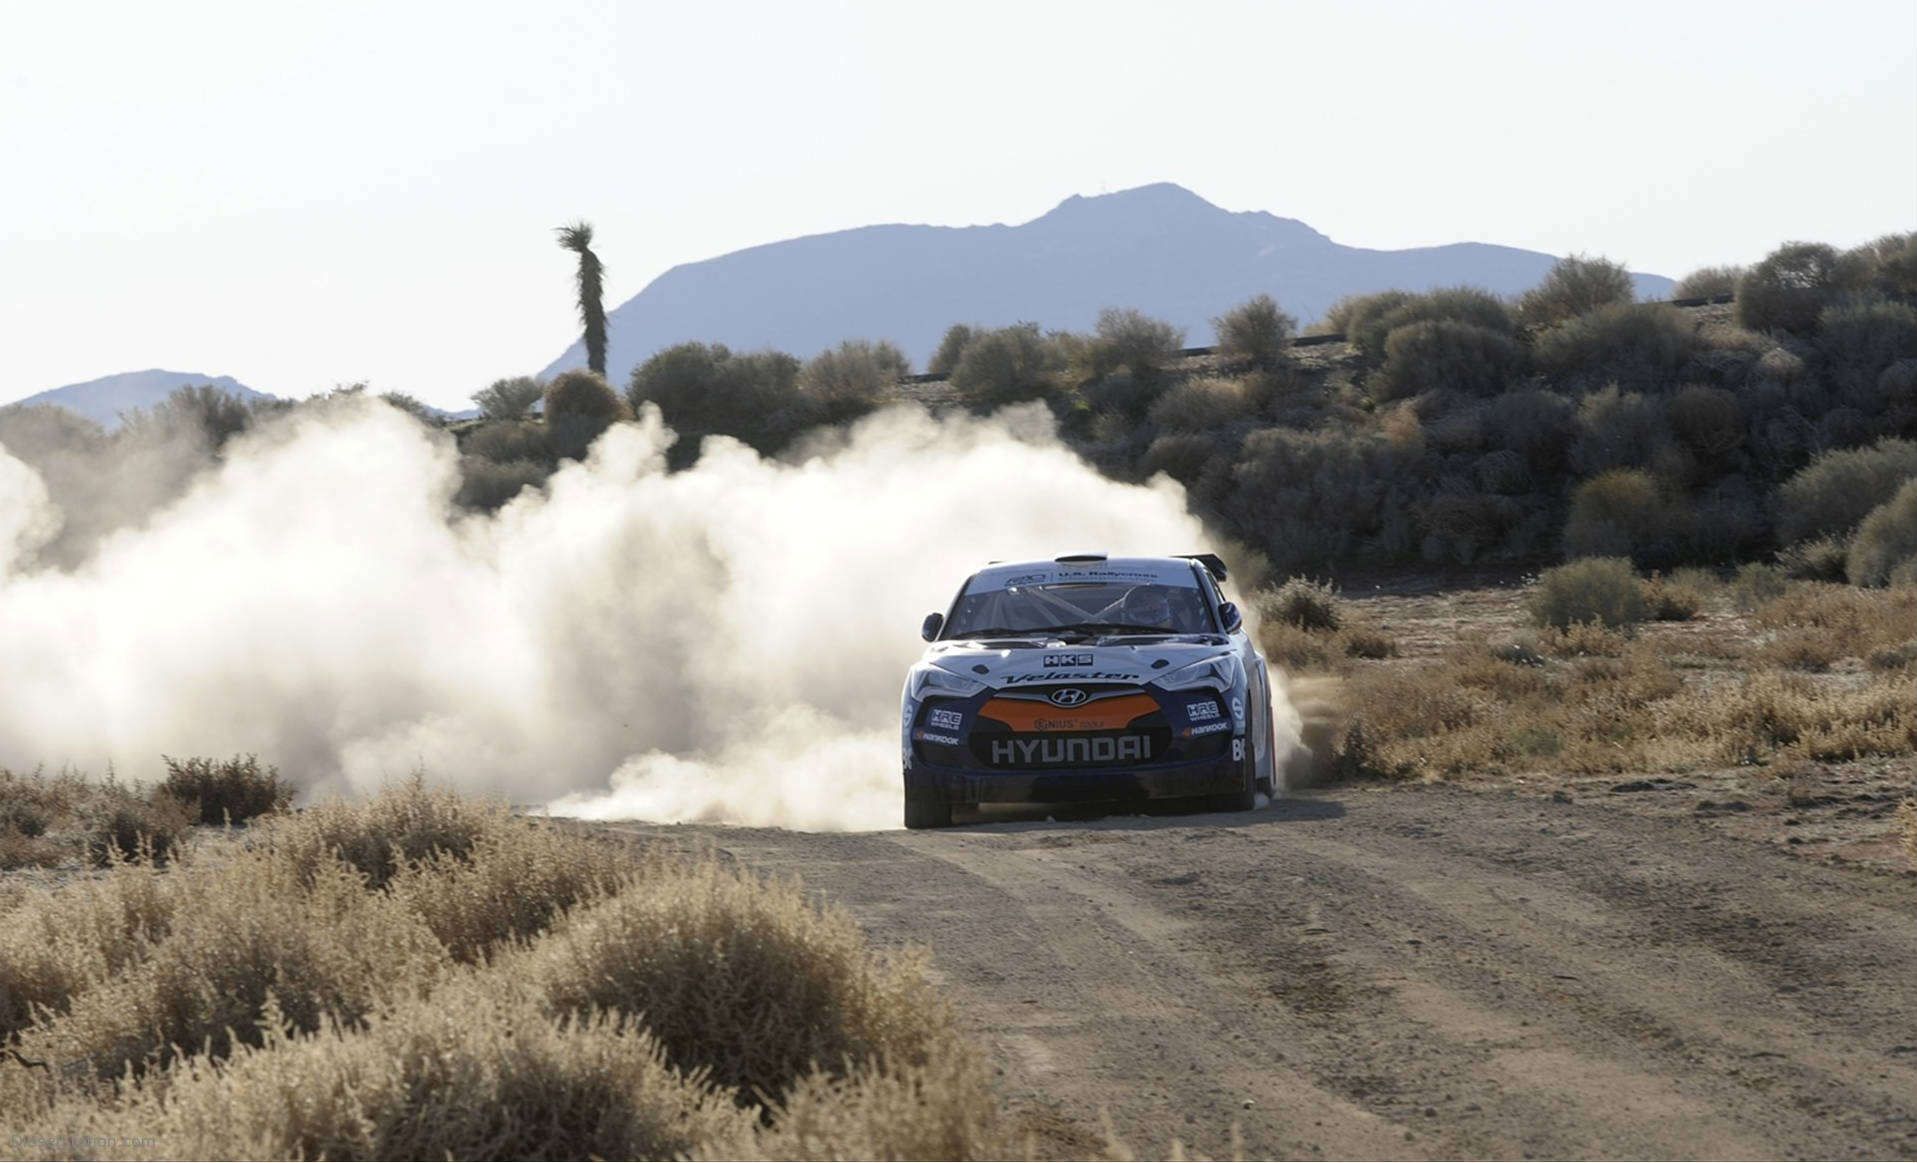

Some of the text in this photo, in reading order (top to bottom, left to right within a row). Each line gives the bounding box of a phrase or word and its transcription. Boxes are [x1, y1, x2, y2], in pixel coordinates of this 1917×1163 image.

[1044, 654, 1094, 667] HKS
[1001, 672, 1140, 684] Veloster
[931, 708, 963, 725] HRE
[1187, 701, 1219, 717] HRE
[992, 735, 1151, 764] HYUNDAI
